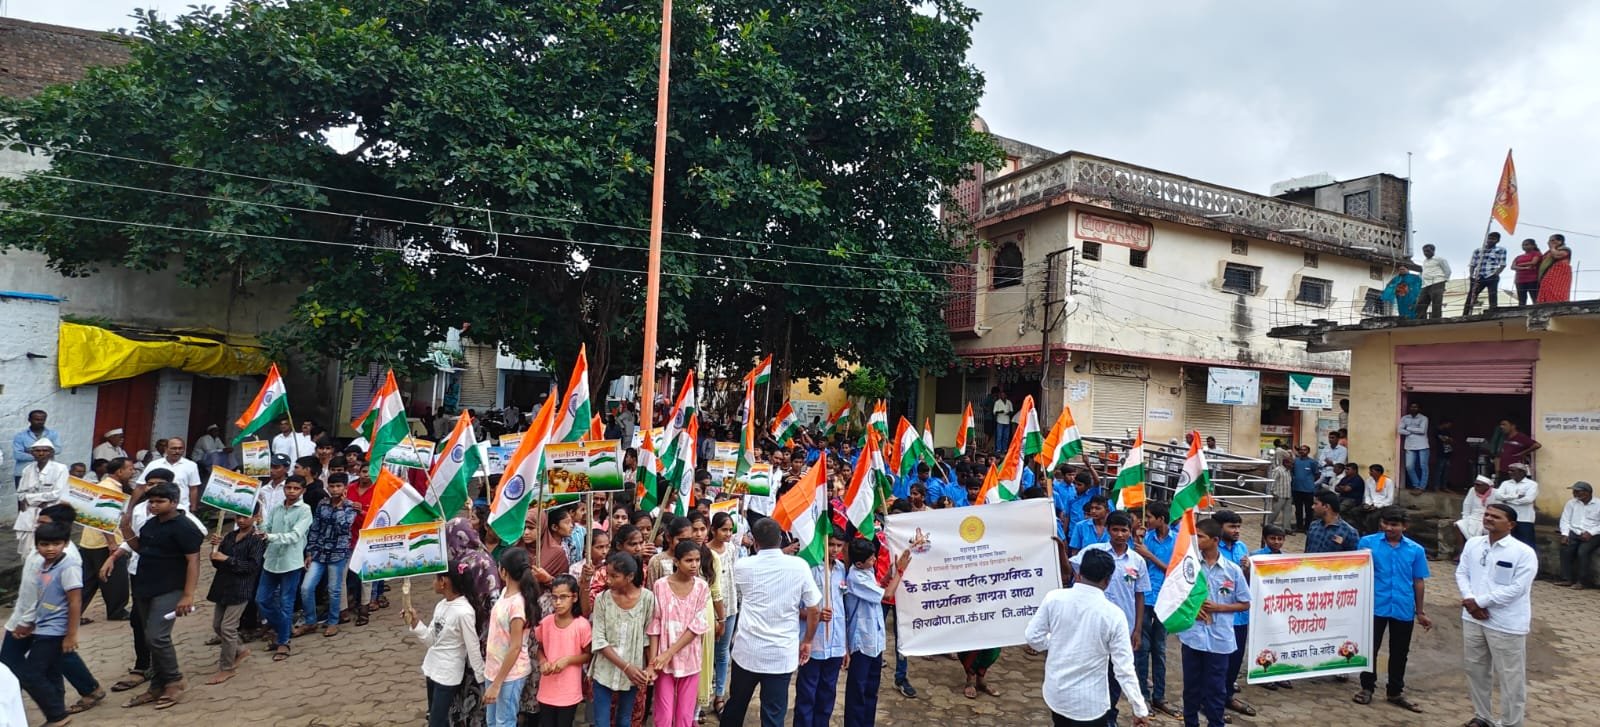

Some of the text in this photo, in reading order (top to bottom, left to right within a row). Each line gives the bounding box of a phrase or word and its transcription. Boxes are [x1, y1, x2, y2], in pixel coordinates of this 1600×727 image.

[921, 578, 950, 592] शंकर
[954, 573, 987, 589] पाटील
[988, 566, 1032, 585] प्राथमिक
[1034, 567, 1043, 577] व
[921, 586, 1034, 610] माध्यमिक आश्रम शाळा
[1263, 587, 1358, 615] माध्यमिक आश्रम शाळा
